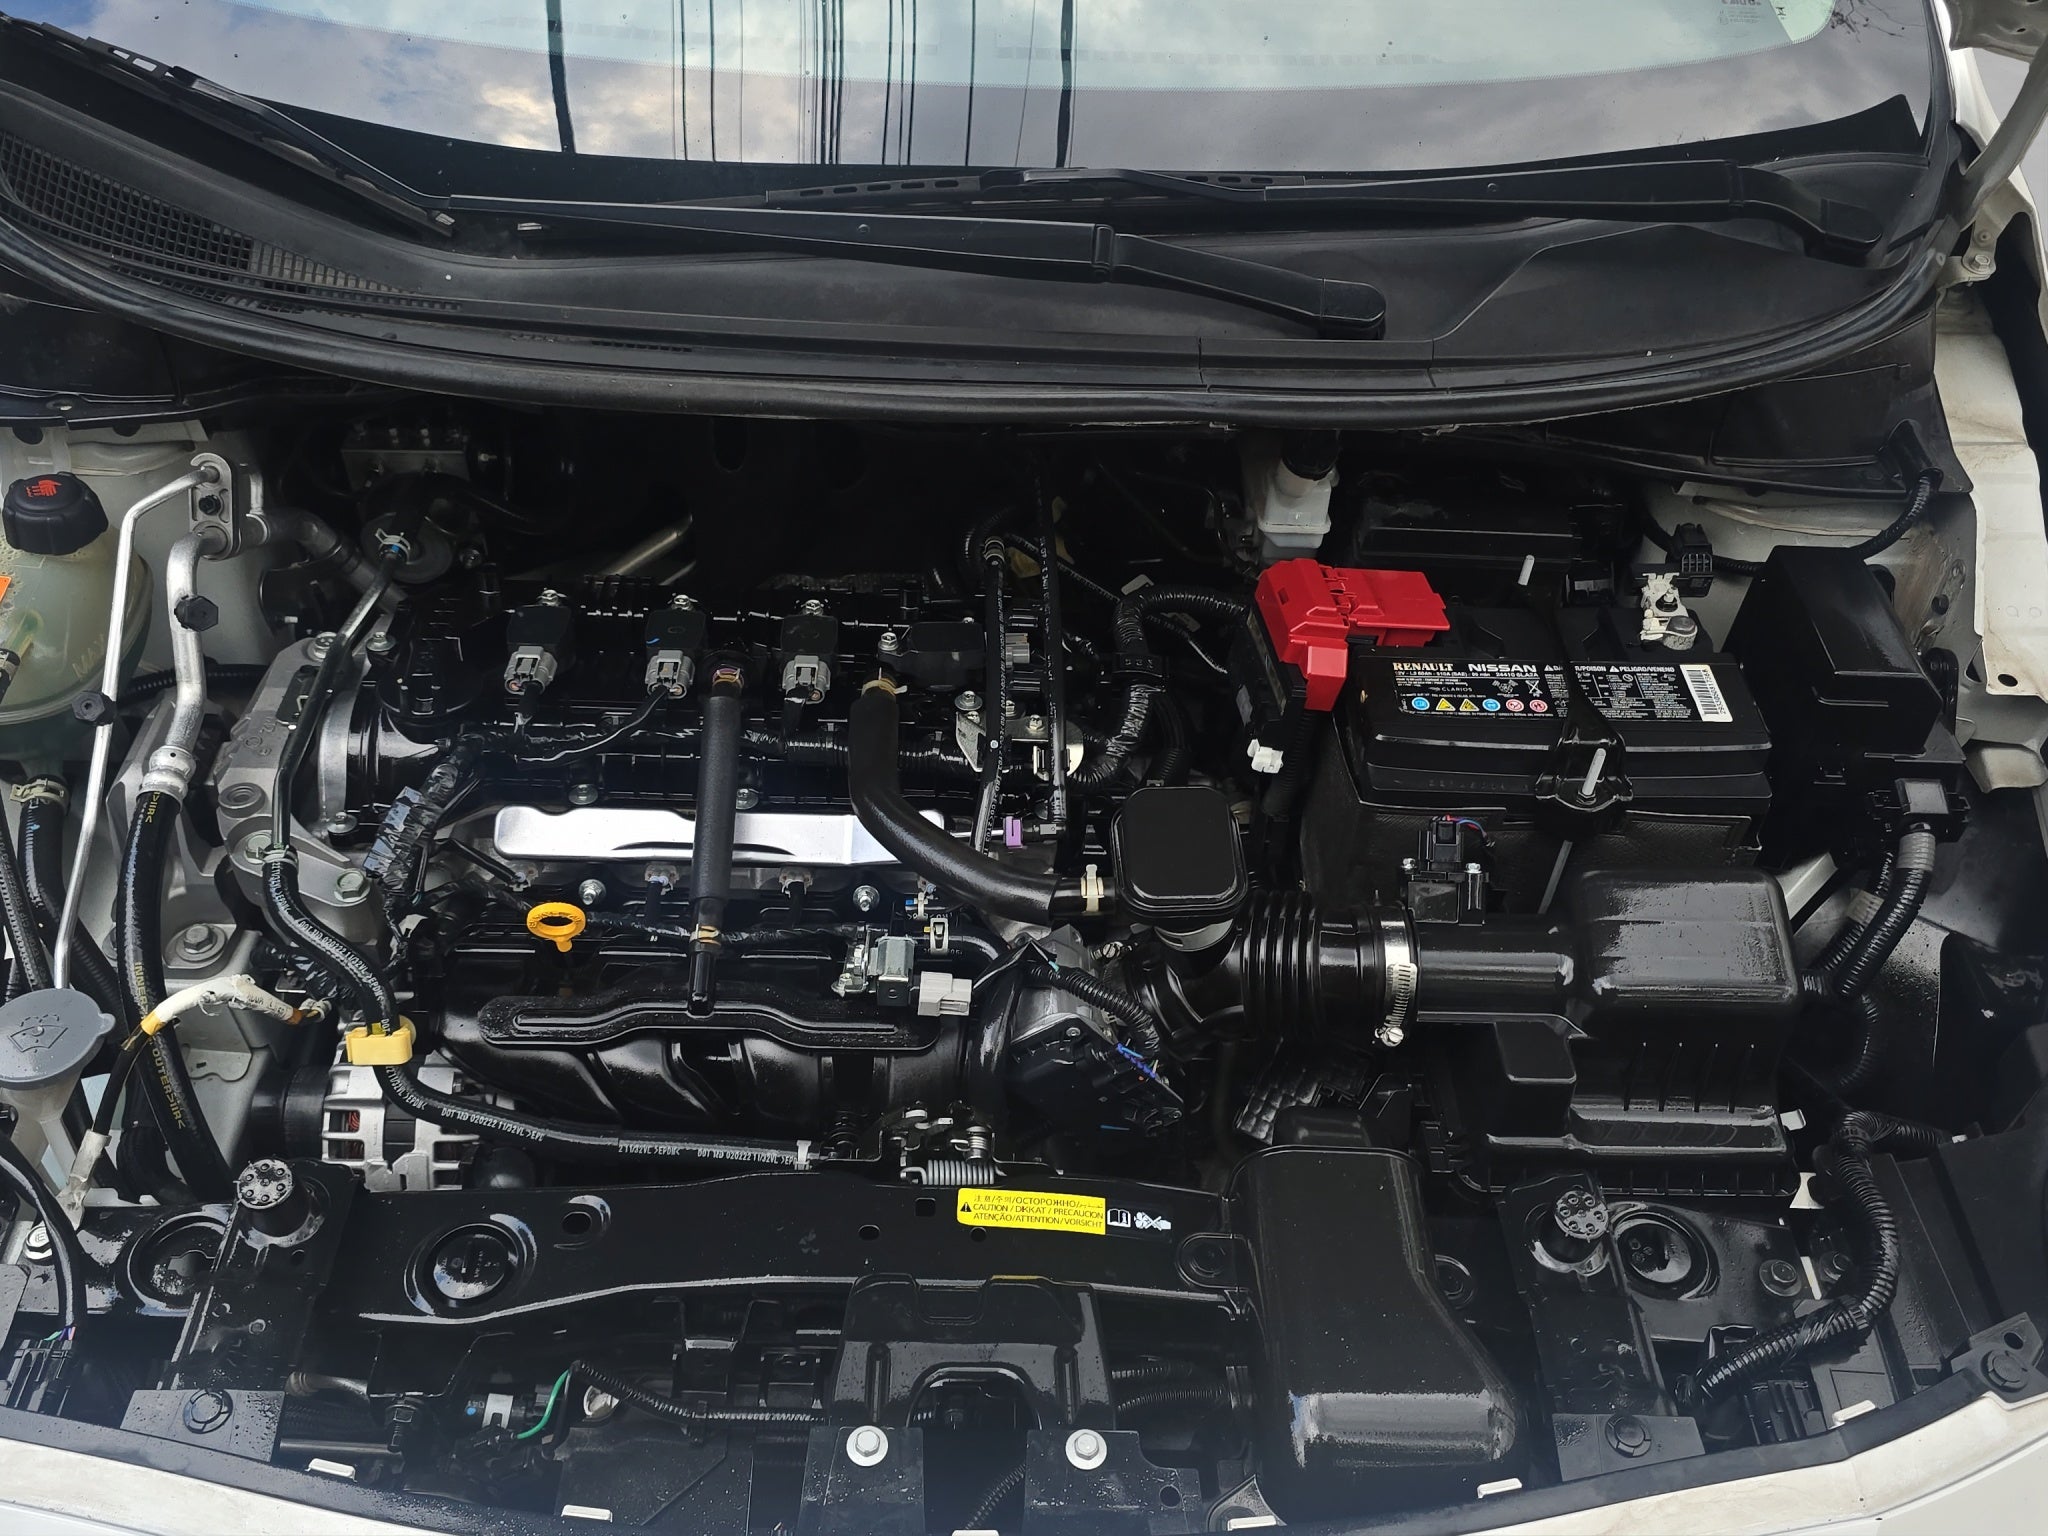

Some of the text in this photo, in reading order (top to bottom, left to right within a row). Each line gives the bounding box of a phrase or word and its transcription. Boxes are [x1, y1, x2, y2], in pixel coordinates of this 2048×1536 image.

[1393, 662, 1453, 671] RENAULT
[1468, 663, 1537, 672] NISSAN
[441, 1107, 455, 1117] DOT
[469, 1115, 497, 1128] 020222
[697, 1149, 710, 1157] DOT
[726, 1151, 751, 1161] 020222
[973, 1203, 1008, 1211] CAUTION
[1054, 1208, 1103, 1219] PRECAUCION
